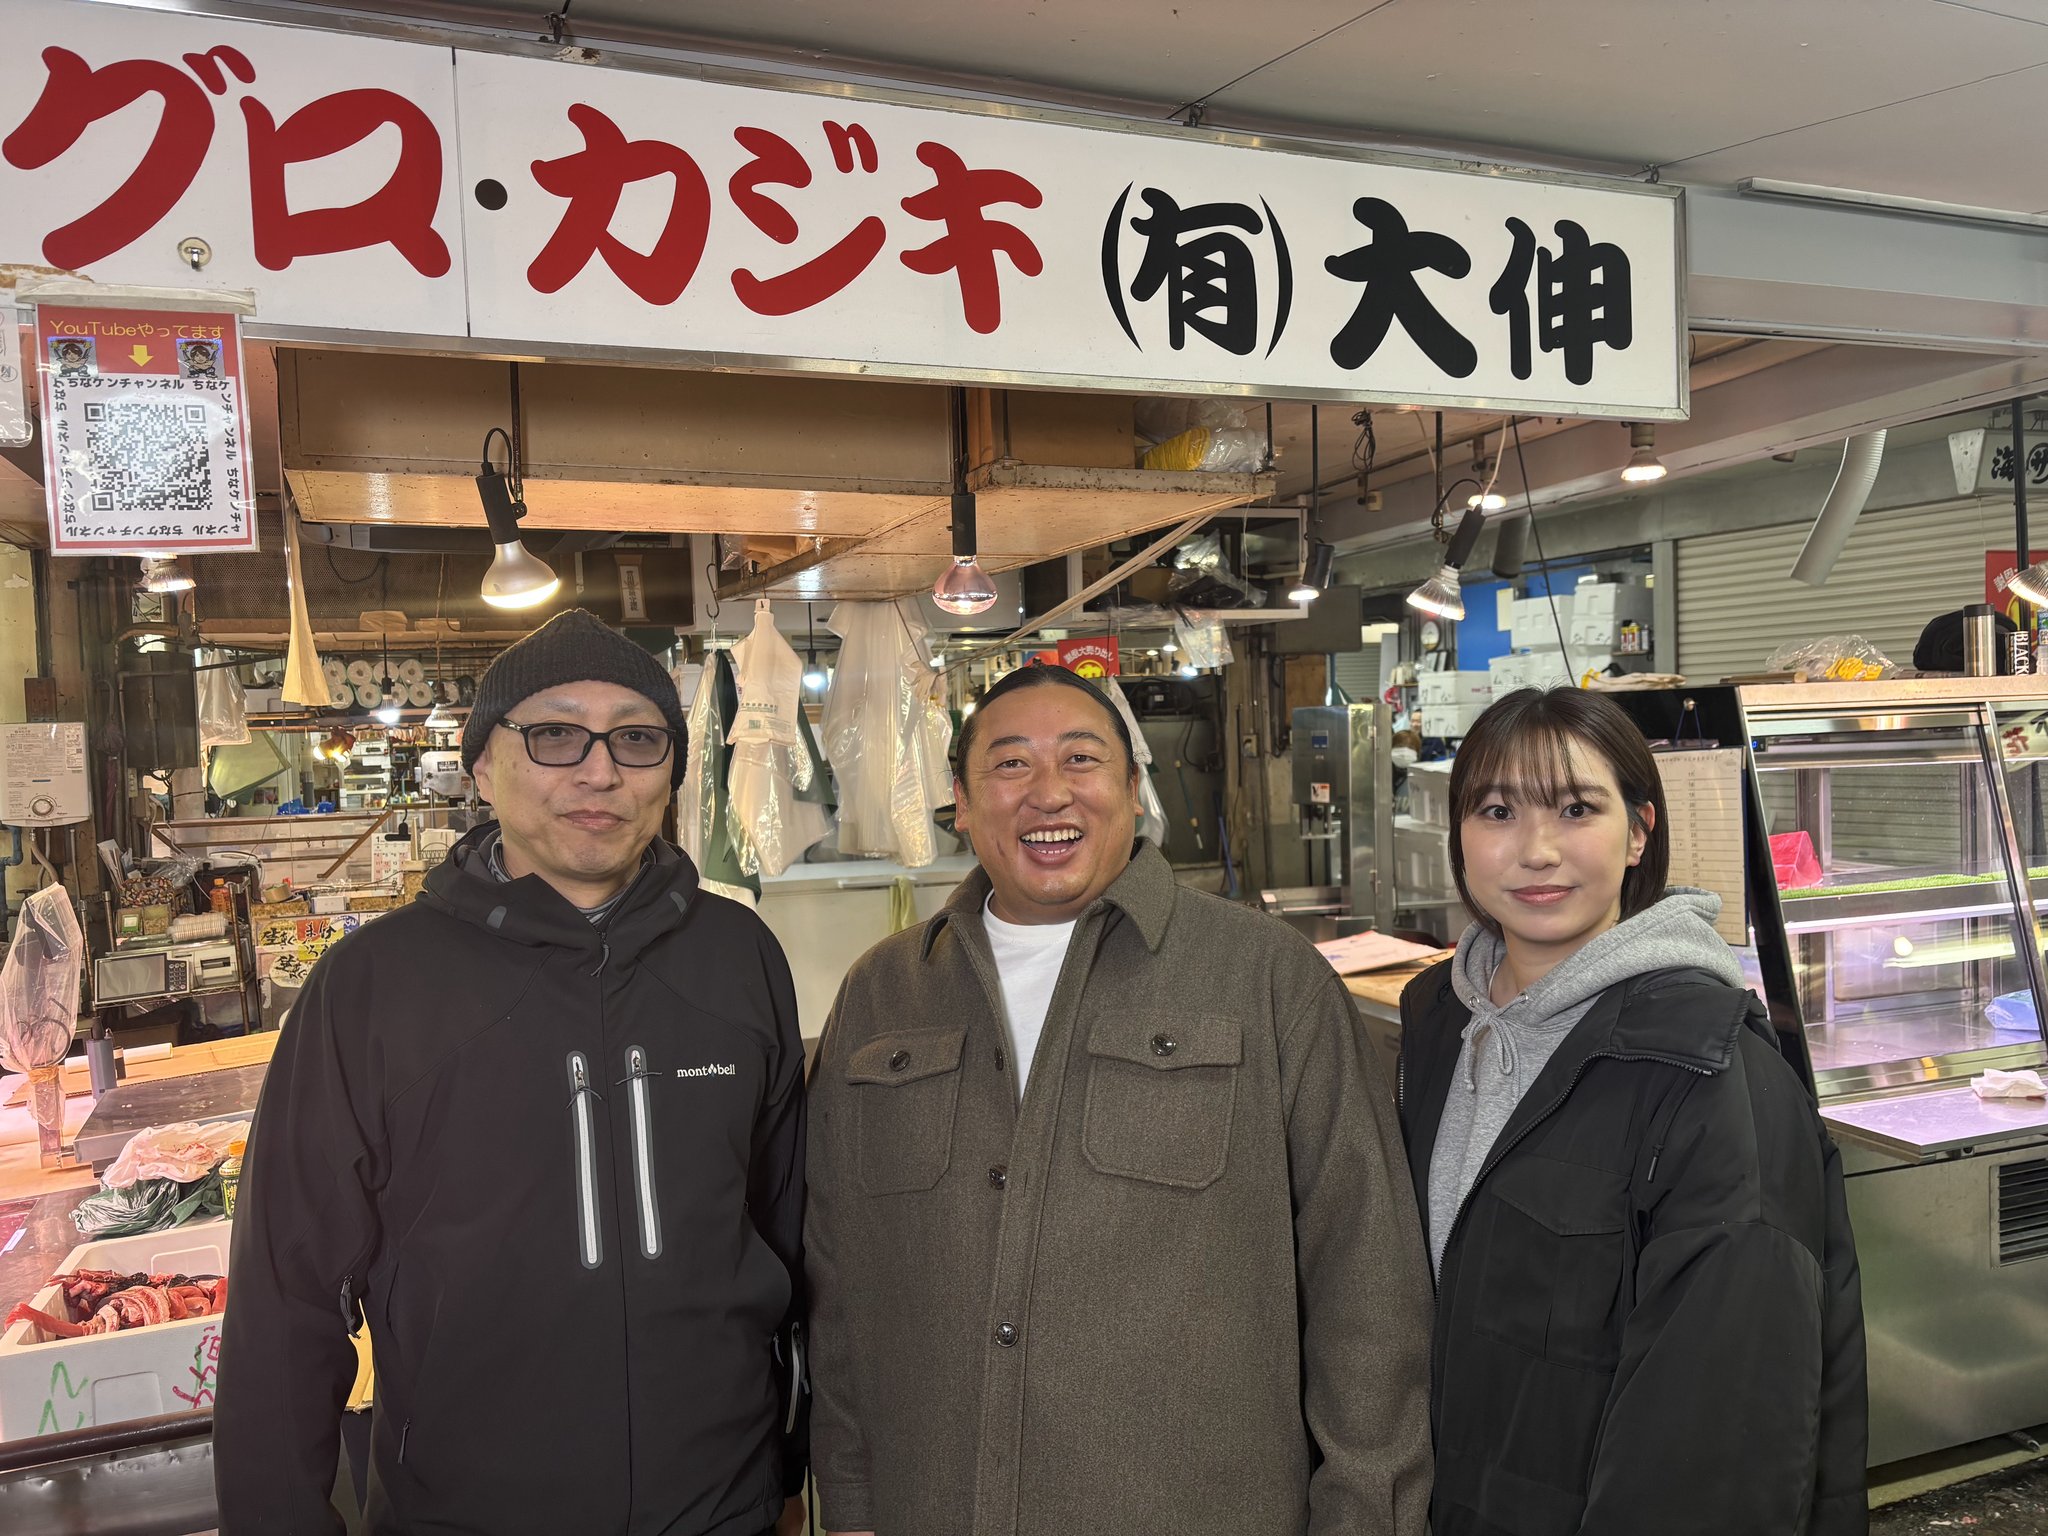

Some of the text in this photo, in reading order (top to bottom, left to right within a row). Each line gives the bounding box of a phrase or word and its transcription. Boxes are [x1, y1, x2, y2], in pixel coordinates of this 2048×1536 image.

[3, 46, 1043, 335] グロ・カジキ
[50, 320, 224, 339] YouTubeやってます
[68, 378, 230, 391] ちなケンチャンネル ちなケ
[2015, 633, 2029, 676] BLACK
[677, 1063, 736, 1078] montbell
